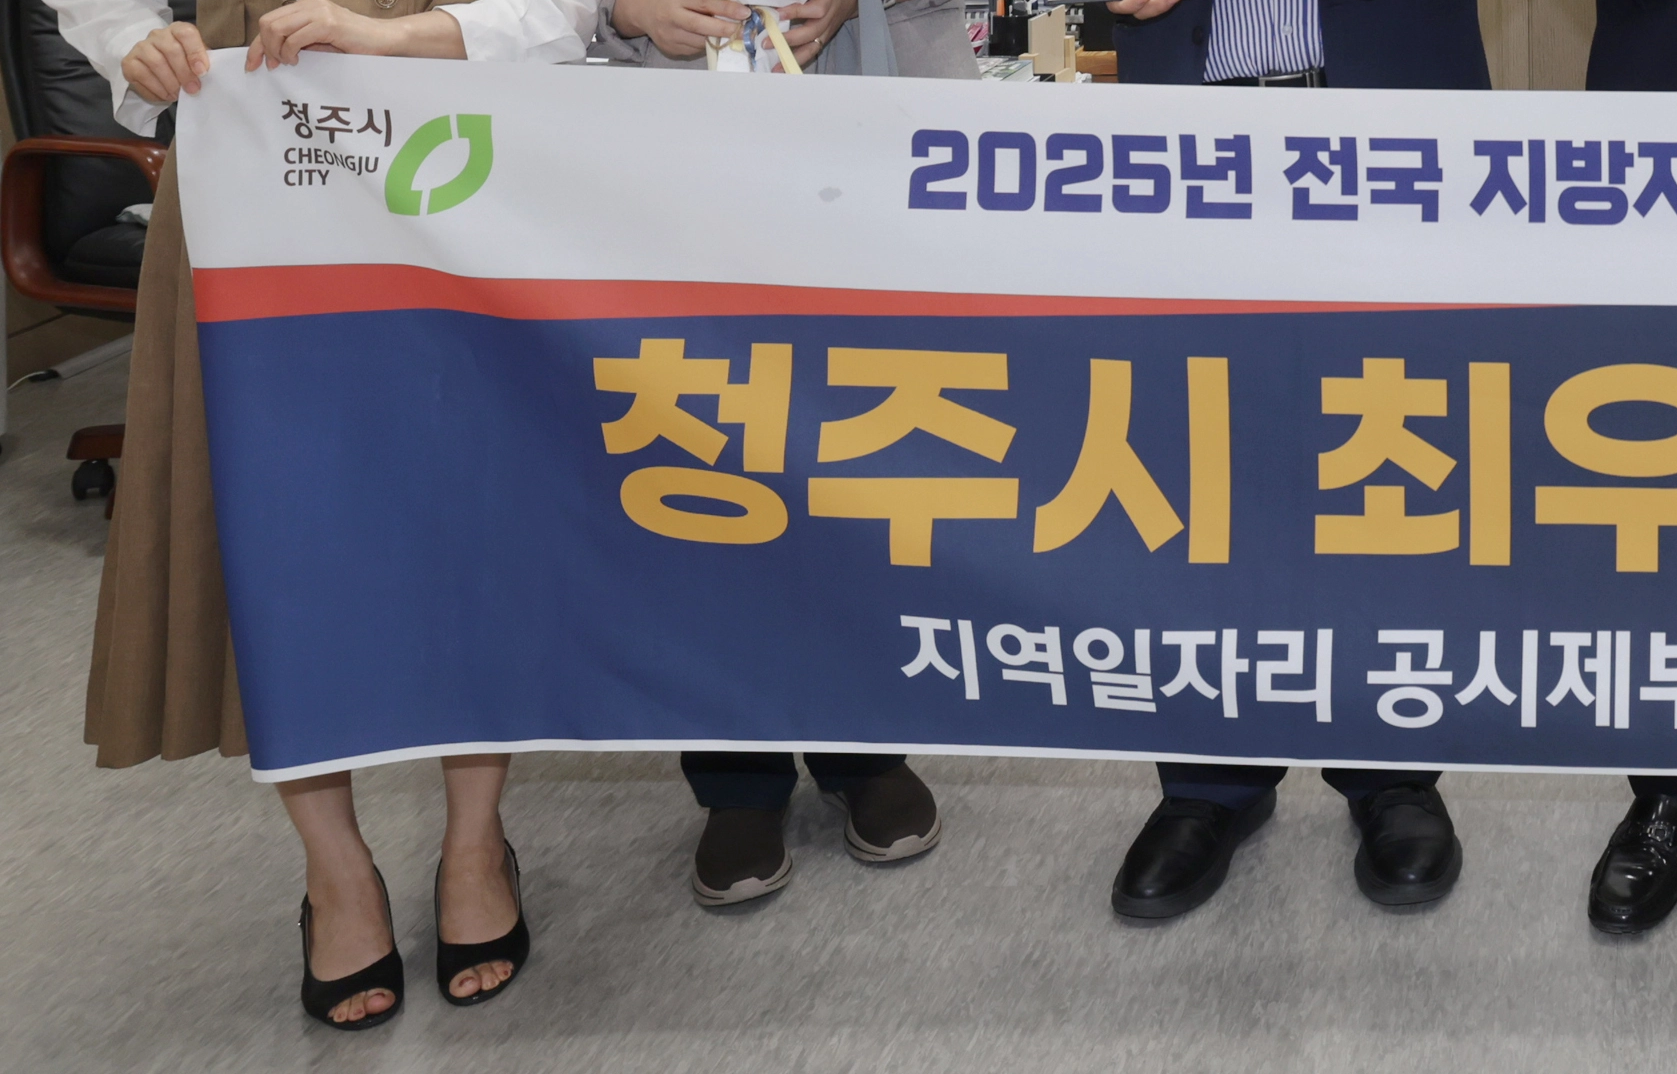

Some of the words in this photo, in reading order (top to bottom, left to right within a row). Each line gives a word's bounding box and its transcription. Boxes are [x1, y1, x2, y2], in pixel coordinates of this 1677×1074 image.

[282, 99, 392, 147] 청주시
[284, 147, 379, 176] CHEONGJU
[284, 169, 330, 186] CITY
[910, 131, 1251, 218] 2025년
[1286, 138, 1442, 221] 전국
[594, 340, 1230, 566] 청주시
[898, 614, 1333, 724] 지역일자리
